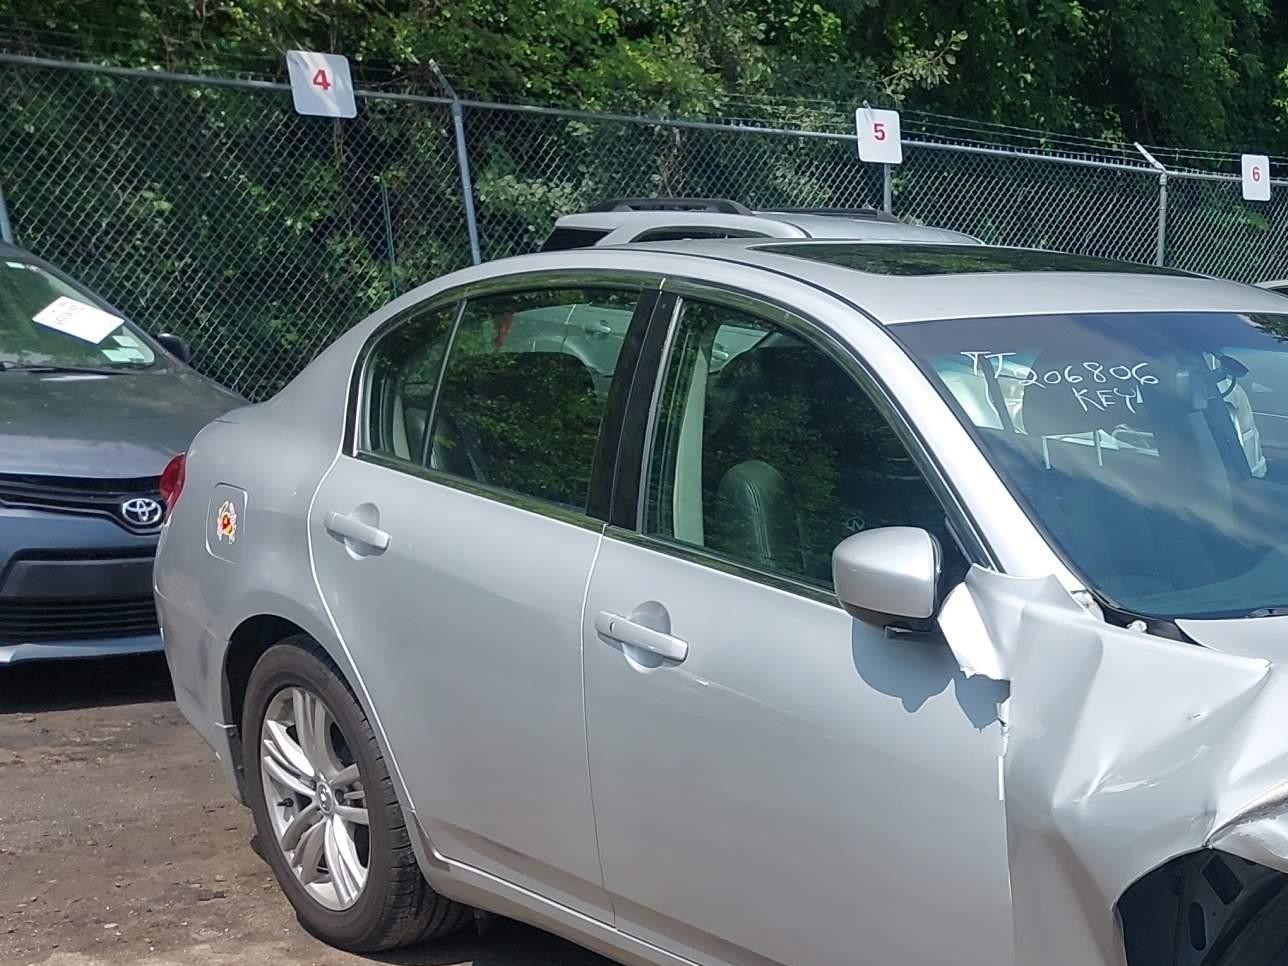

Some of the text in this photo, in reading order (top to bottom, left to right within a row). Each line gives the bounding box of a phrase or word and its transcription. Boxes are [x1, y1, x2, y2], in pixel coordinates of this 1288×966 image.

[313, 69, 331, 90] 4
[874, 123, 885, 141] 5
[1252, 166, 1260, 182] 6
[1072, 387, 1136, 414] KEY
